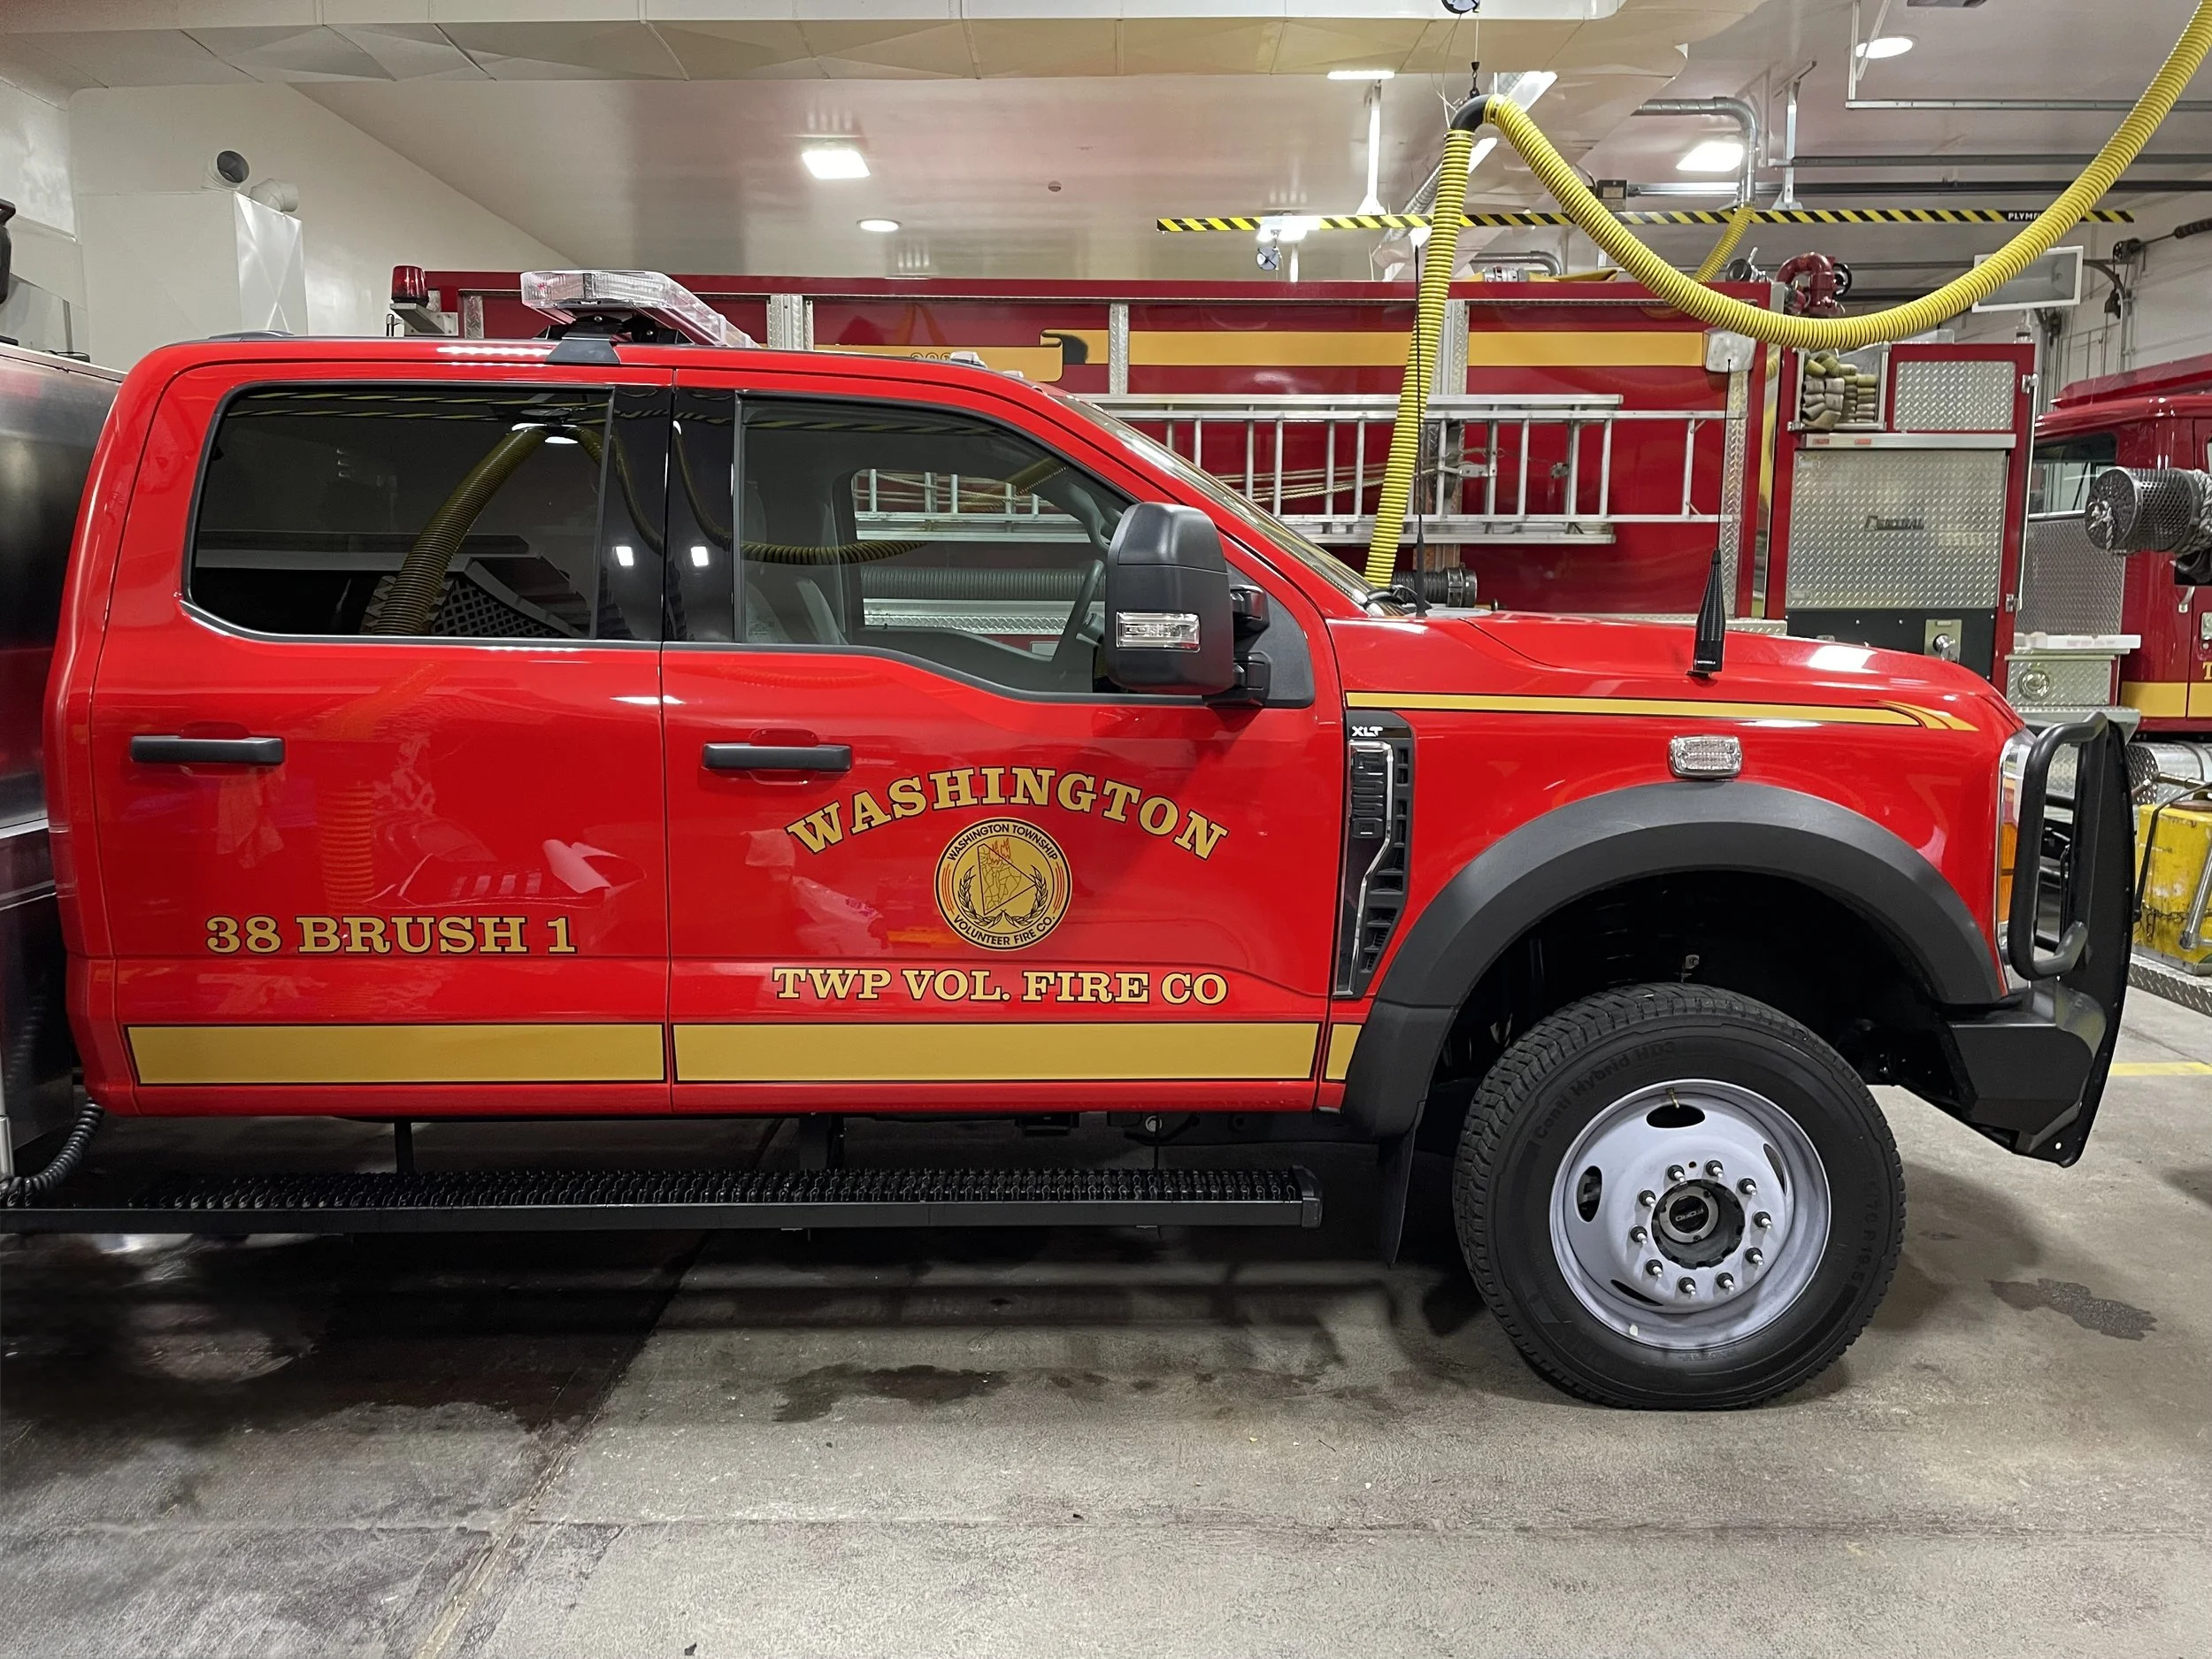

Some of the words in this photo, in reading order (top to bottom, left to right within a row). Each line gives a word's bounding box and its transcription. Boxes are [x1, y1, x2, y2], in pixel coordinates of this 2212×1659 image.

[1351, 726, 1384, 737] XLT
[786, 765, 1228, 862] WASHINGTON
[947, 823, 1010, 862] WASHINGTON
[1012, 824, 1058, 862] TOWNSHIP
[205, 915, 281, 954] 38
[295, 916, 531, 955] BRUSH
[547, 917, 578, 955] 1
[953, 914, 1010, 946] VOLUNTEER
[1014, 929, 1036, 944] FIRE
[1037, 915, 1056, 933] CO.
[772, 967, 891, 1001] TWP
[902, 969, 1011, 1002] VOL.
[1022, 971, 1149, 1004] FIRE
[1161, 972, 1228, 1005] CO
